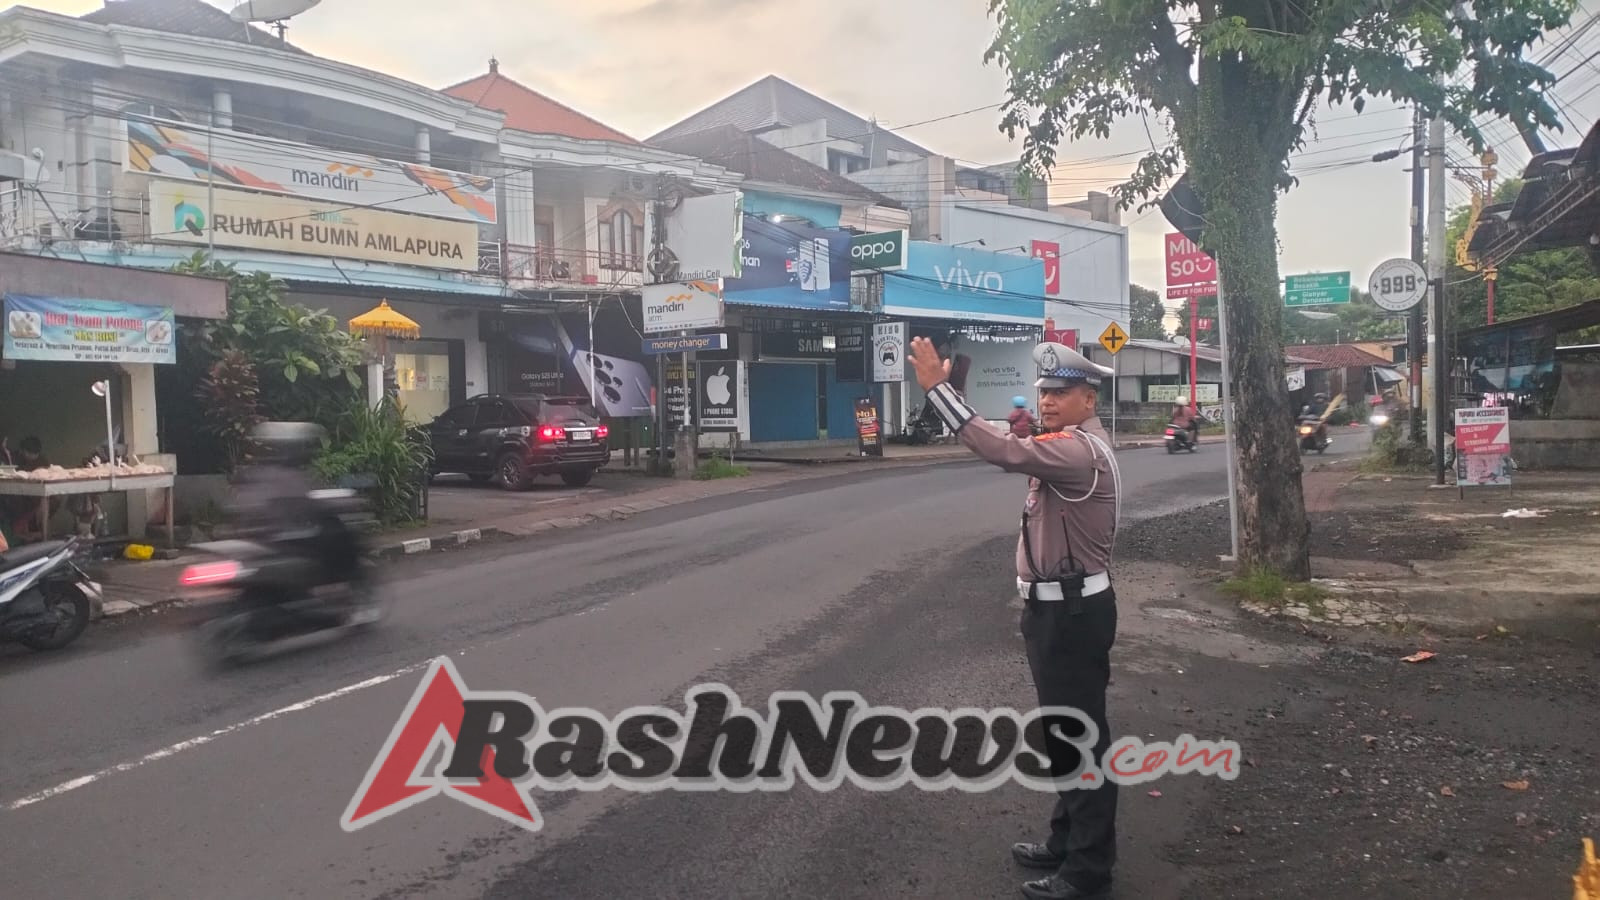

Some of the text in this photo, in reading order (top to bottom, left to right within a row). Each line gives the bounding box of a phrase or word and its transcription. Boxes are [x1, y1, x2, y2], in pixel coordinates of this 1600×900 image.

[292, 168, 359, 192] mandiri
[213, 213, 463, 260] RUMAH BUMN AMLAPURA
[851, 240, 895, 261] oppo
[933, 259, 1003, 294] vivo
[1381, 275, 1416, 294] 999
[1168, 289, 1181, 297] LIFE
[1190, 287, 1203, 295] FOR
[1204, 286, 1217, 294] FUN
[647, 301, 685, 315] mandiri
[651, 338, 710, 350] money changer
